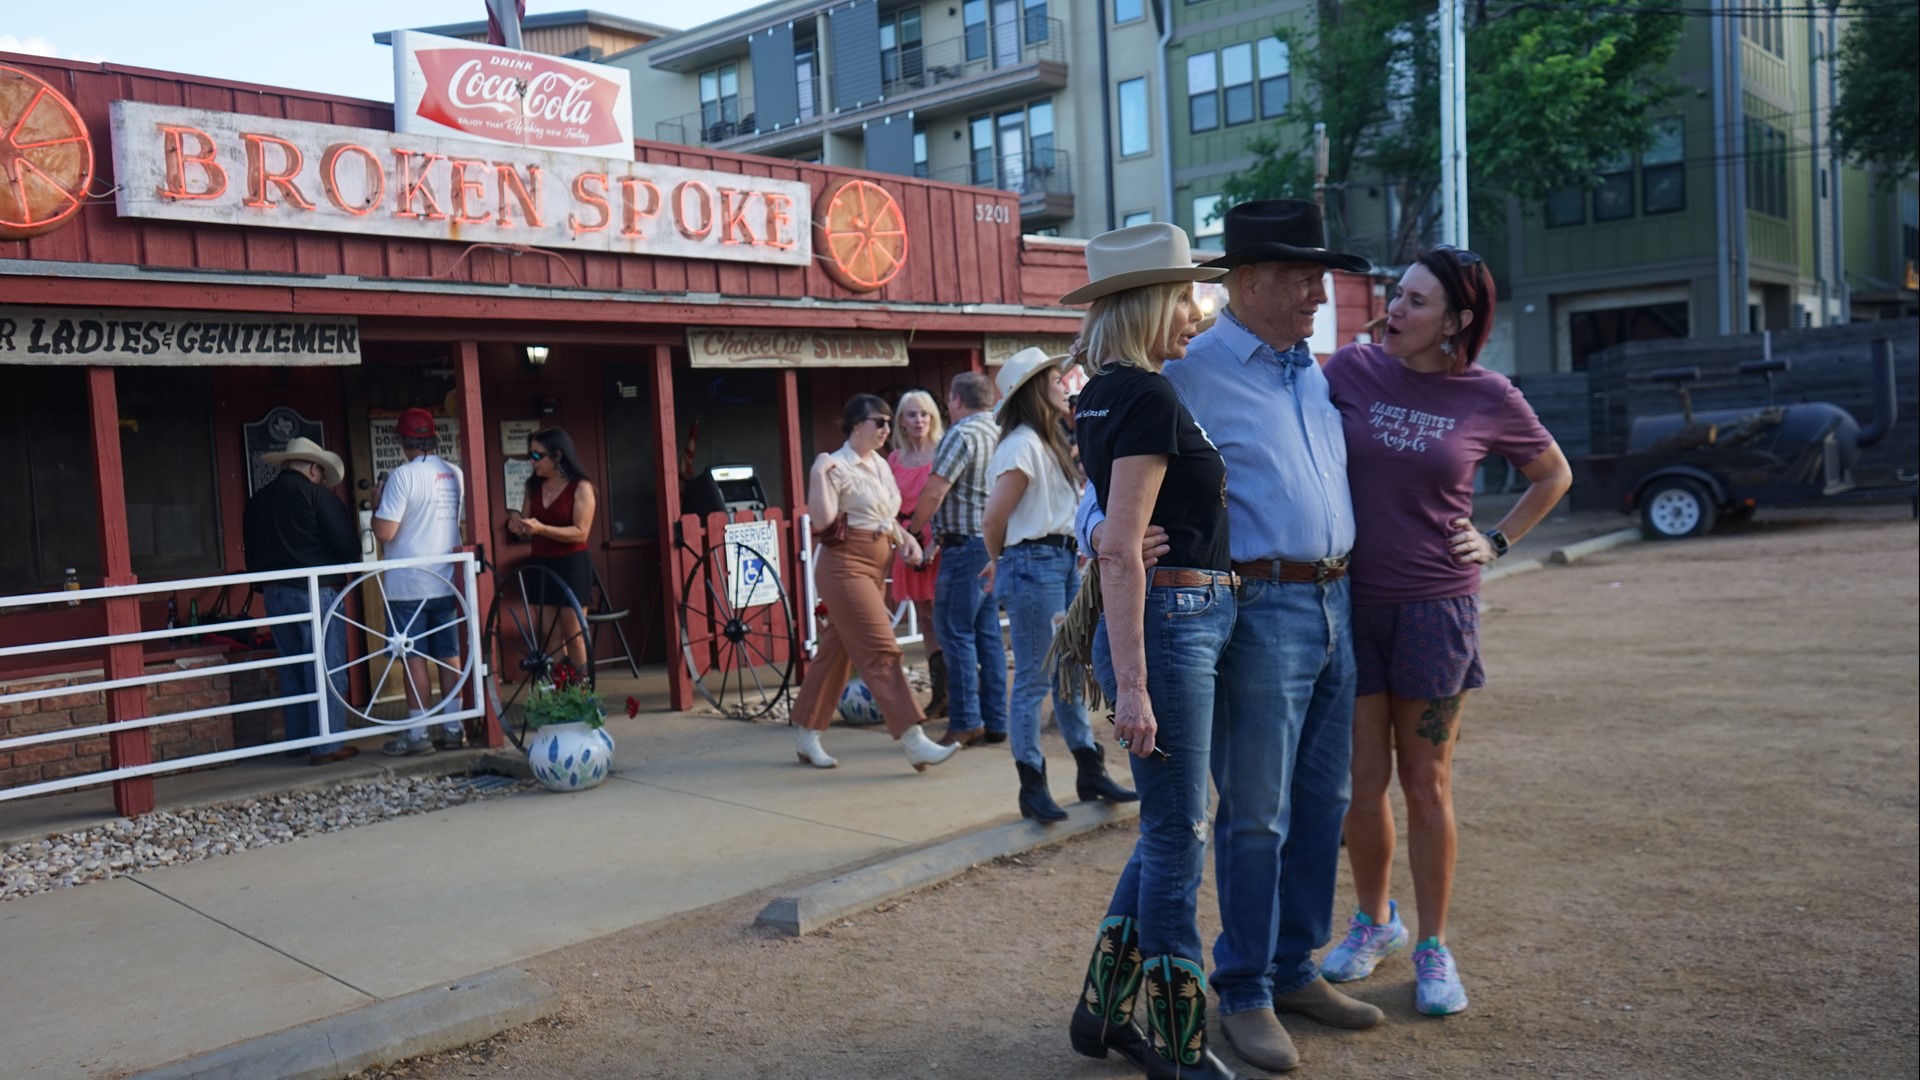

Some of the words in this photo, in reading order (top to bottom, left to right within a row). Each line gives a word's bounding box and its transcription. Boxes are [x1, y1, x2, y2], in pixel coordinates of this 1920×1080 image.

[489, 55, 534, 71] DRINK
[457, 117, 482, 127] ENJOY
[486, 120, 503, 129] THAT
[545, 129, 561, 137] NEW
[155, 123, 545, 229] BROKEN
[568, 171, 796, 250] SPOKE
[975, 203, 1010, 224] 3201
[27, 317, 165, 355] LADIES
[177, 321, 357, 355] GENTLEMEN
[703, 328, 772, 357] Choice
[811, 333, 897, 360] STEAKS
[1368, 414, 1410, 437] Honky
[1369, 401, 1408, 420] JAMES
[1408, 409, 1456, 431] WHITE'S
[433, 423, 449, 432] HIS
[376, 447, 401, 458] BEST
[1372, 431, 1430, 453] Angels
[728, 526, 772, 545] RESERVED
